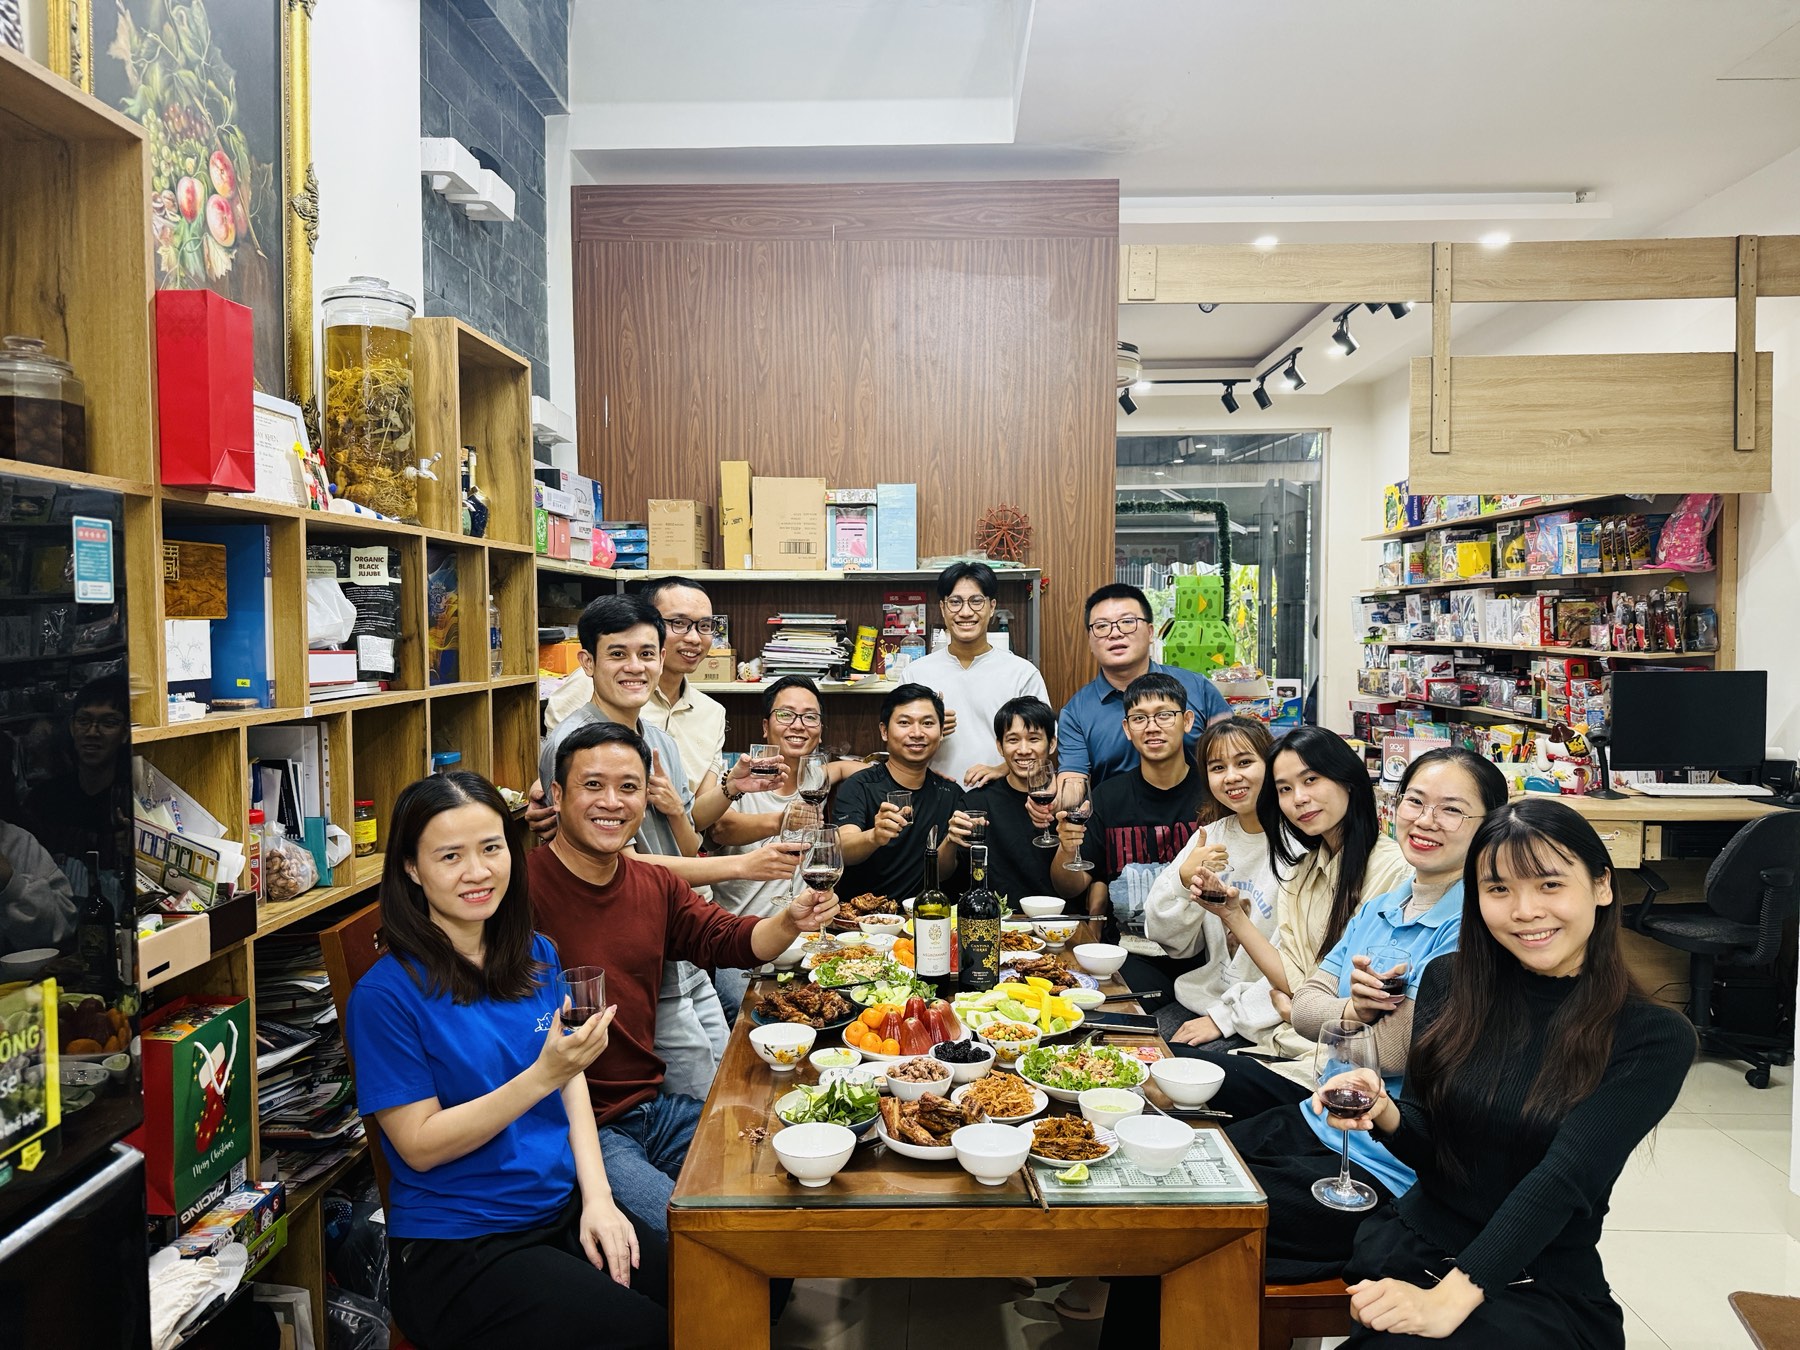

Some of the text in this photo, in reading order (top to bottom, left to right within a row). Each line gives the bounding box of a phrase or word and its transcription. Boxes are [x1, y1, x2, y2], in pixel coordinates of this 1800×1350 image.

[1105, 826, 1151, 874] THE
[1252, 889, 1273, 920] club
[192, 1139, 235, 1178] Merry Christmas
[180, 1178, 227, 1224] RACING
